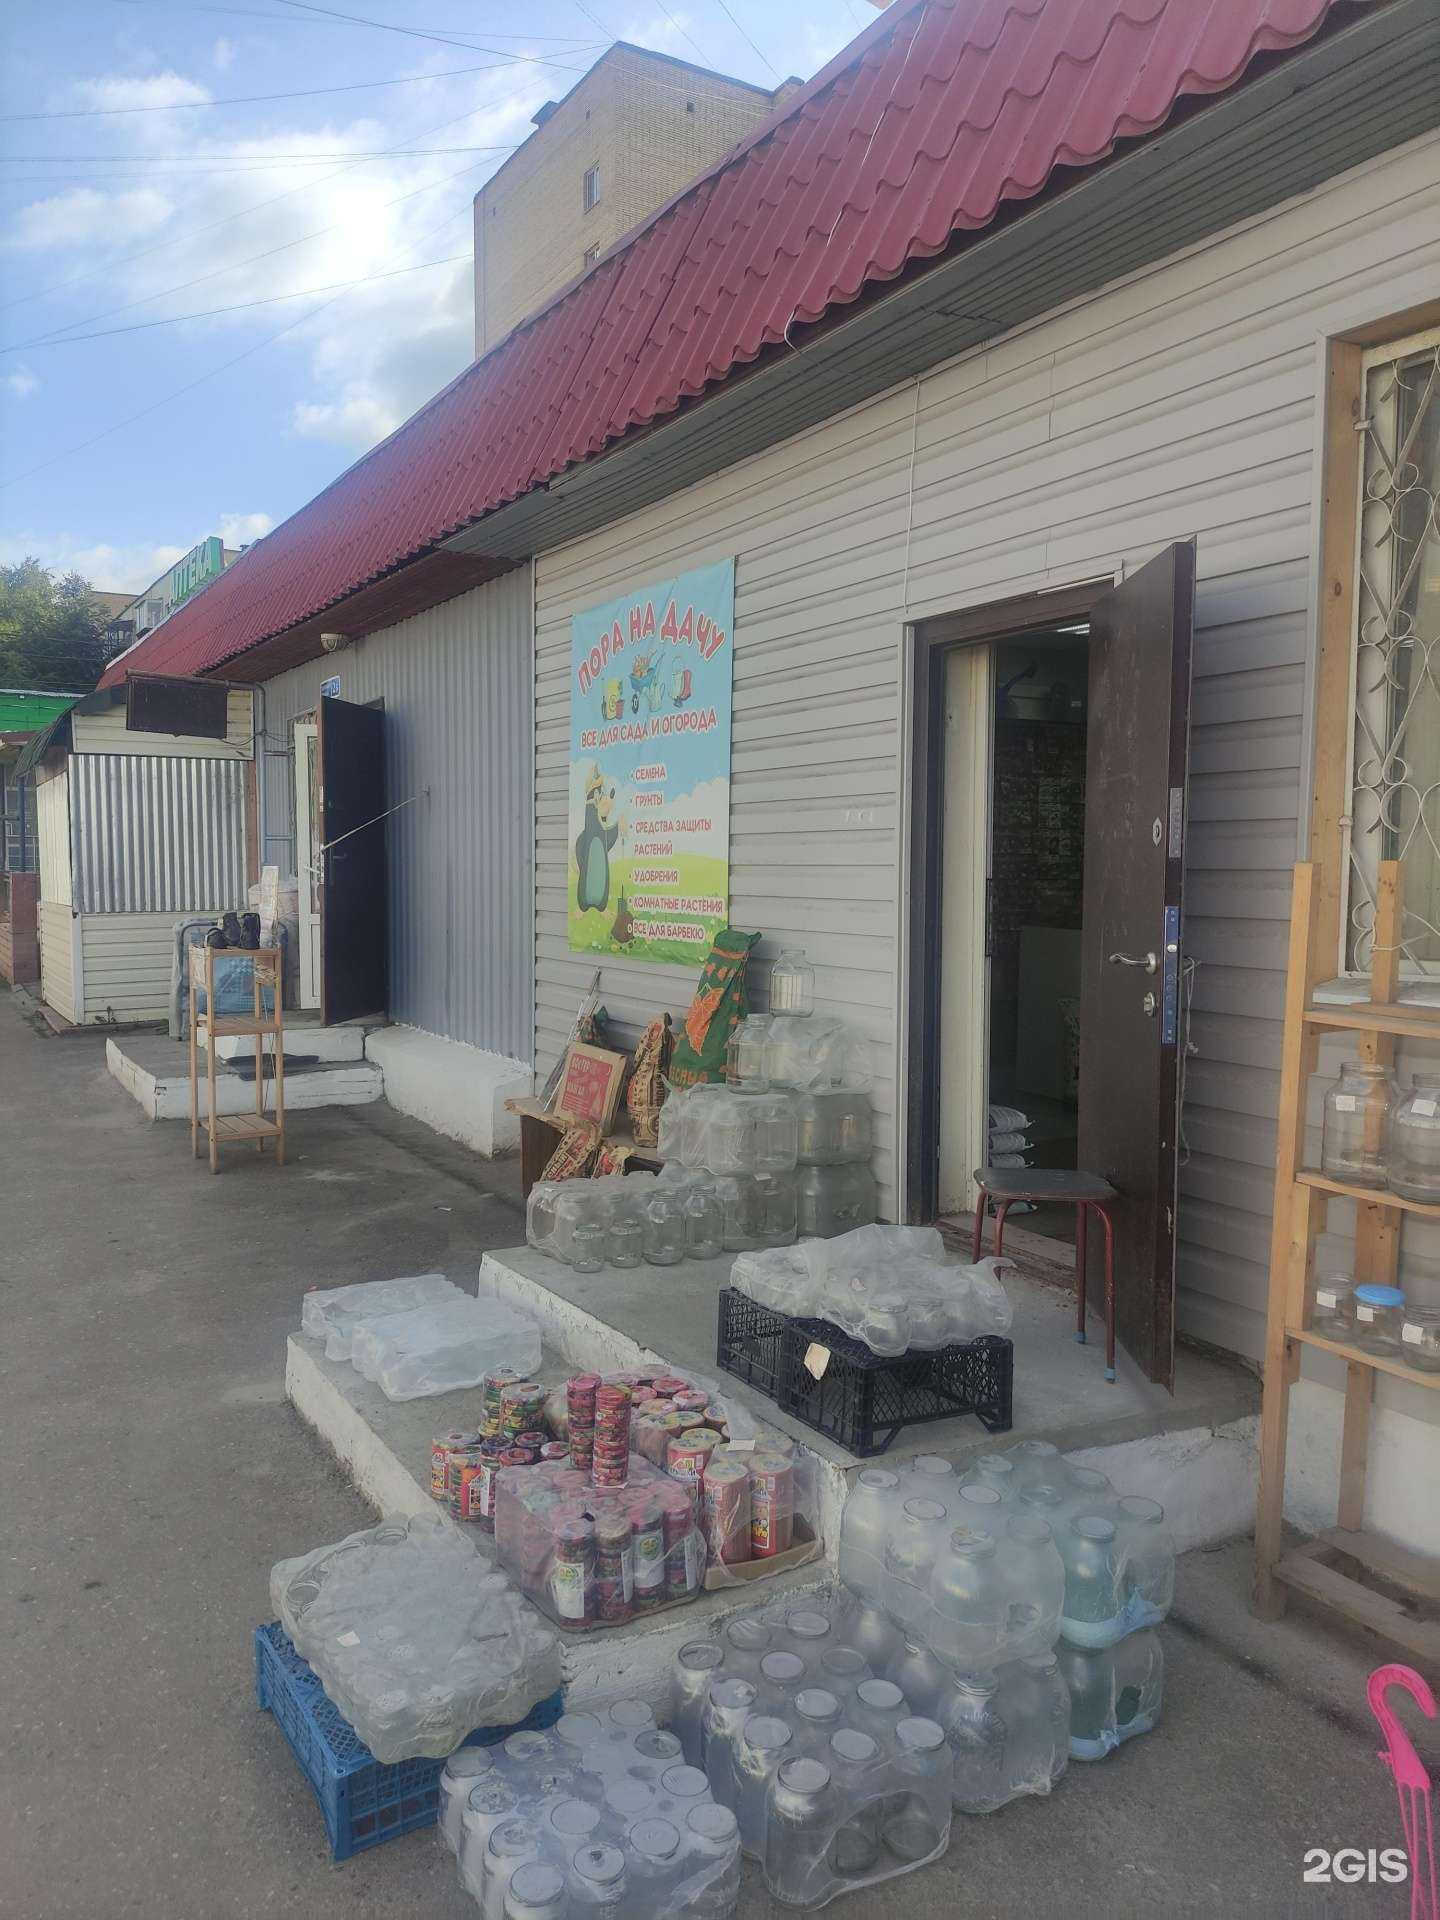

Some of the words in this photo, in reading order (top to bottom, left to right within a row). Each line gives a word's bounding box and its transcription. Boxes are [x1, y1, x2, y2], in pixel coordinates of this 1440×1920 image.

[578, 622, 625, 694] ПОРА
[630, 602, 655, 642] НА
[660, 601, 725, 660] ДАЧУ
[581, 731, 597, 747] ВСЕ
[600, 728, 618, 747] ДЛЯ
[621, 723, 649, 743] САДА
[652, 720, 660, 735] И
[662, 709, 716, 733] ОГОРОДА
[635, 766, 666, 781] СЕМЕНА
[635, 794, 663, 807] ГРУНТЫ
[635, 822, 674, 834] СРЕДСТВА
[675, 819, 712, 832] ЗАЩИТЫ
[634, 840, 673, 855] РАСТЕНИЙ
[634, 870, 678, 883] УДОБРЕНИЯ
[633, 898, 679, 911] КОМНАТНЫЕ
[681, 900, 723, 913] РАСТЕНИЯ
[633, 923, 647, 935] ВСЕ
[649, 924, 666, 937] ДЛЯ
[667, 926, 704, 940] БАРБЕКЮ
